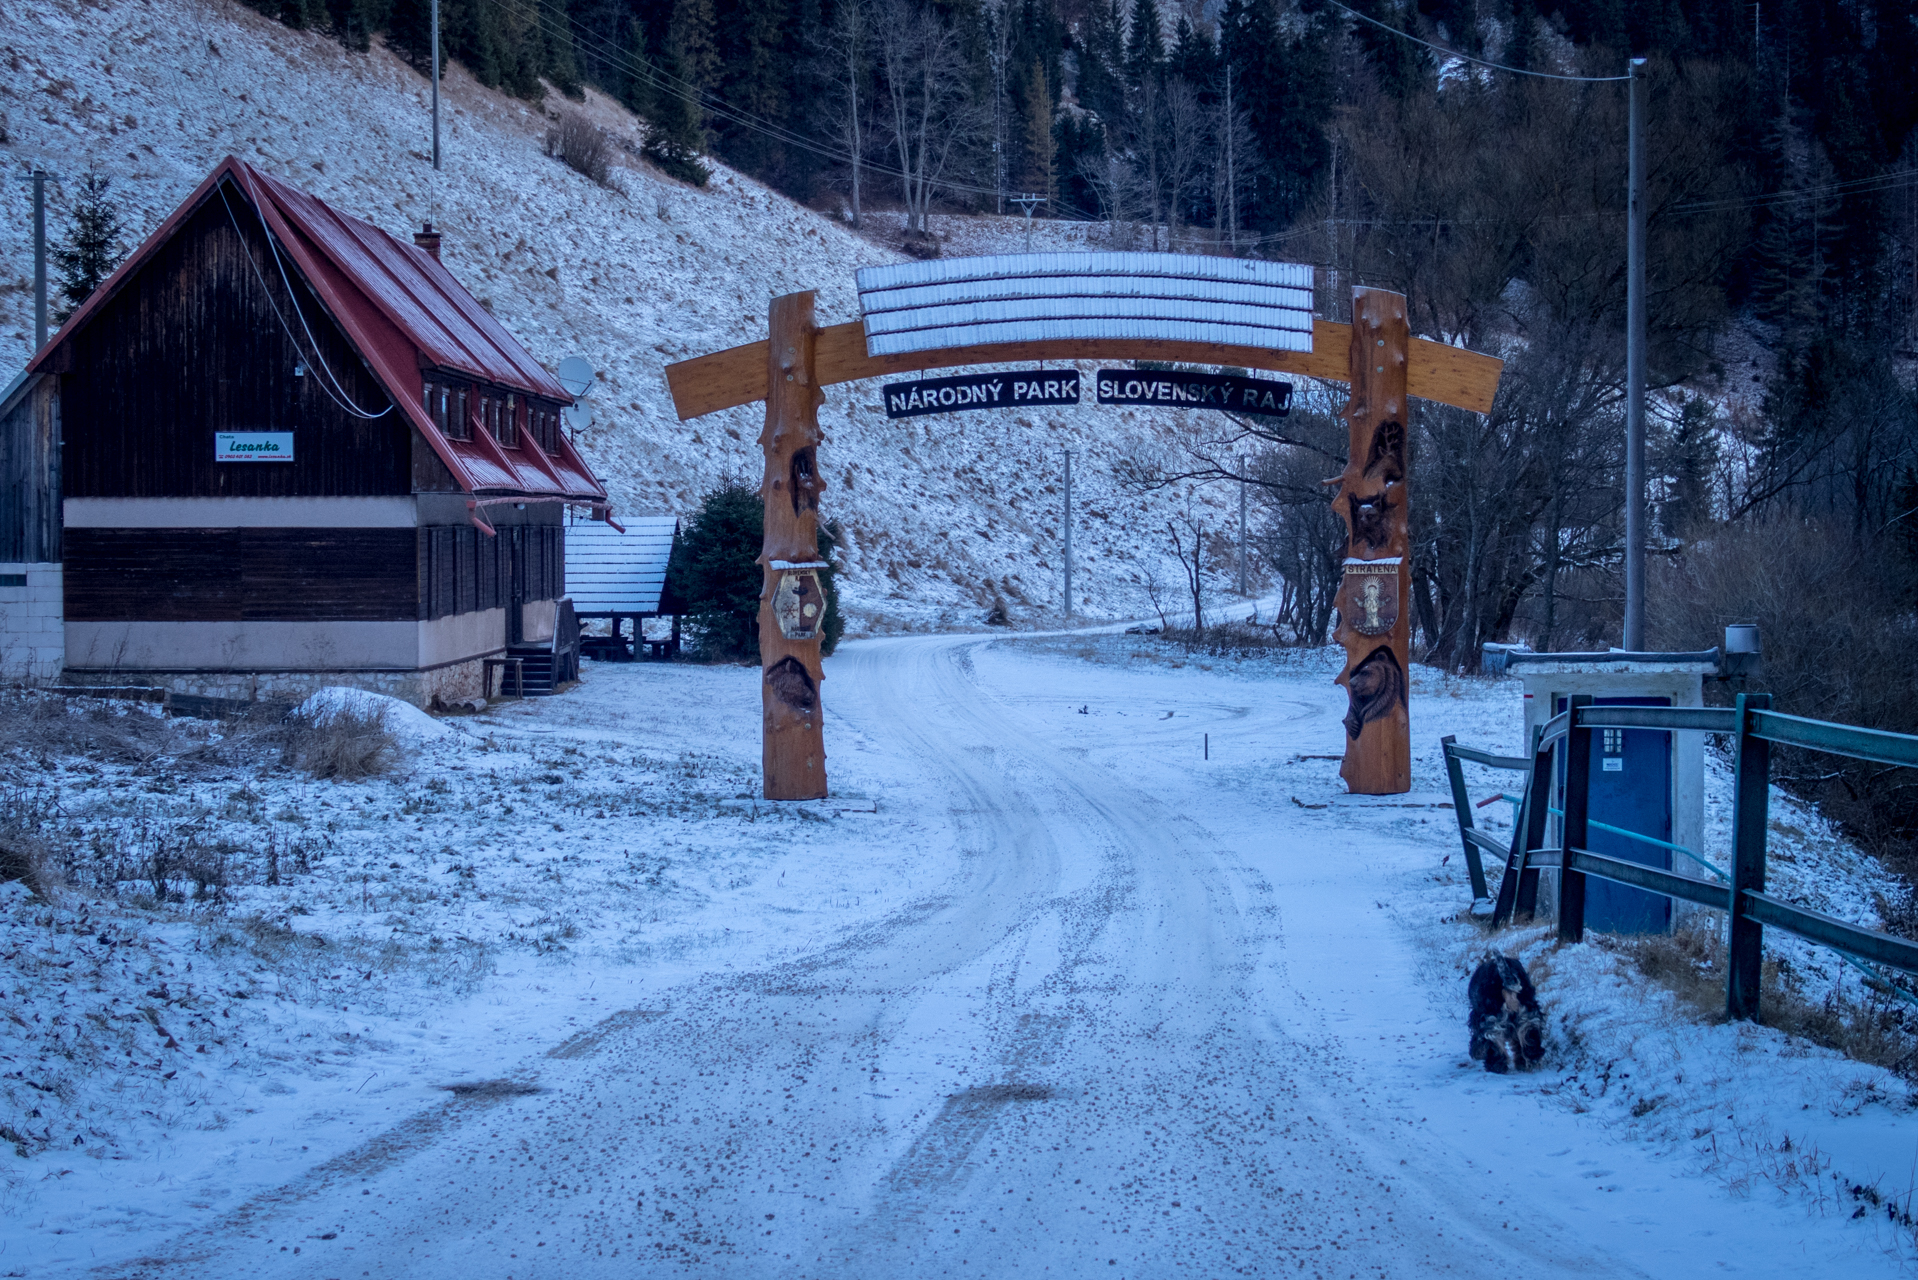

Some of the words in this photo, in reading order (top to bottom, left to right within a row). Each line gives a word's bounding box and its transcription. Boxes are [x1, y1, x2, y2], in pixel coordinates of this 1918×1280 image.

[890, 378, 1003, 412] NÁRODNÝ
[1013, 379, 1077, 400] PARK
[1099, 379, 1234, 404] SLOVENSKÝ
[1242, 388, 1291, 411] RAJ
[230, 440, 280, 452] Lesanka
